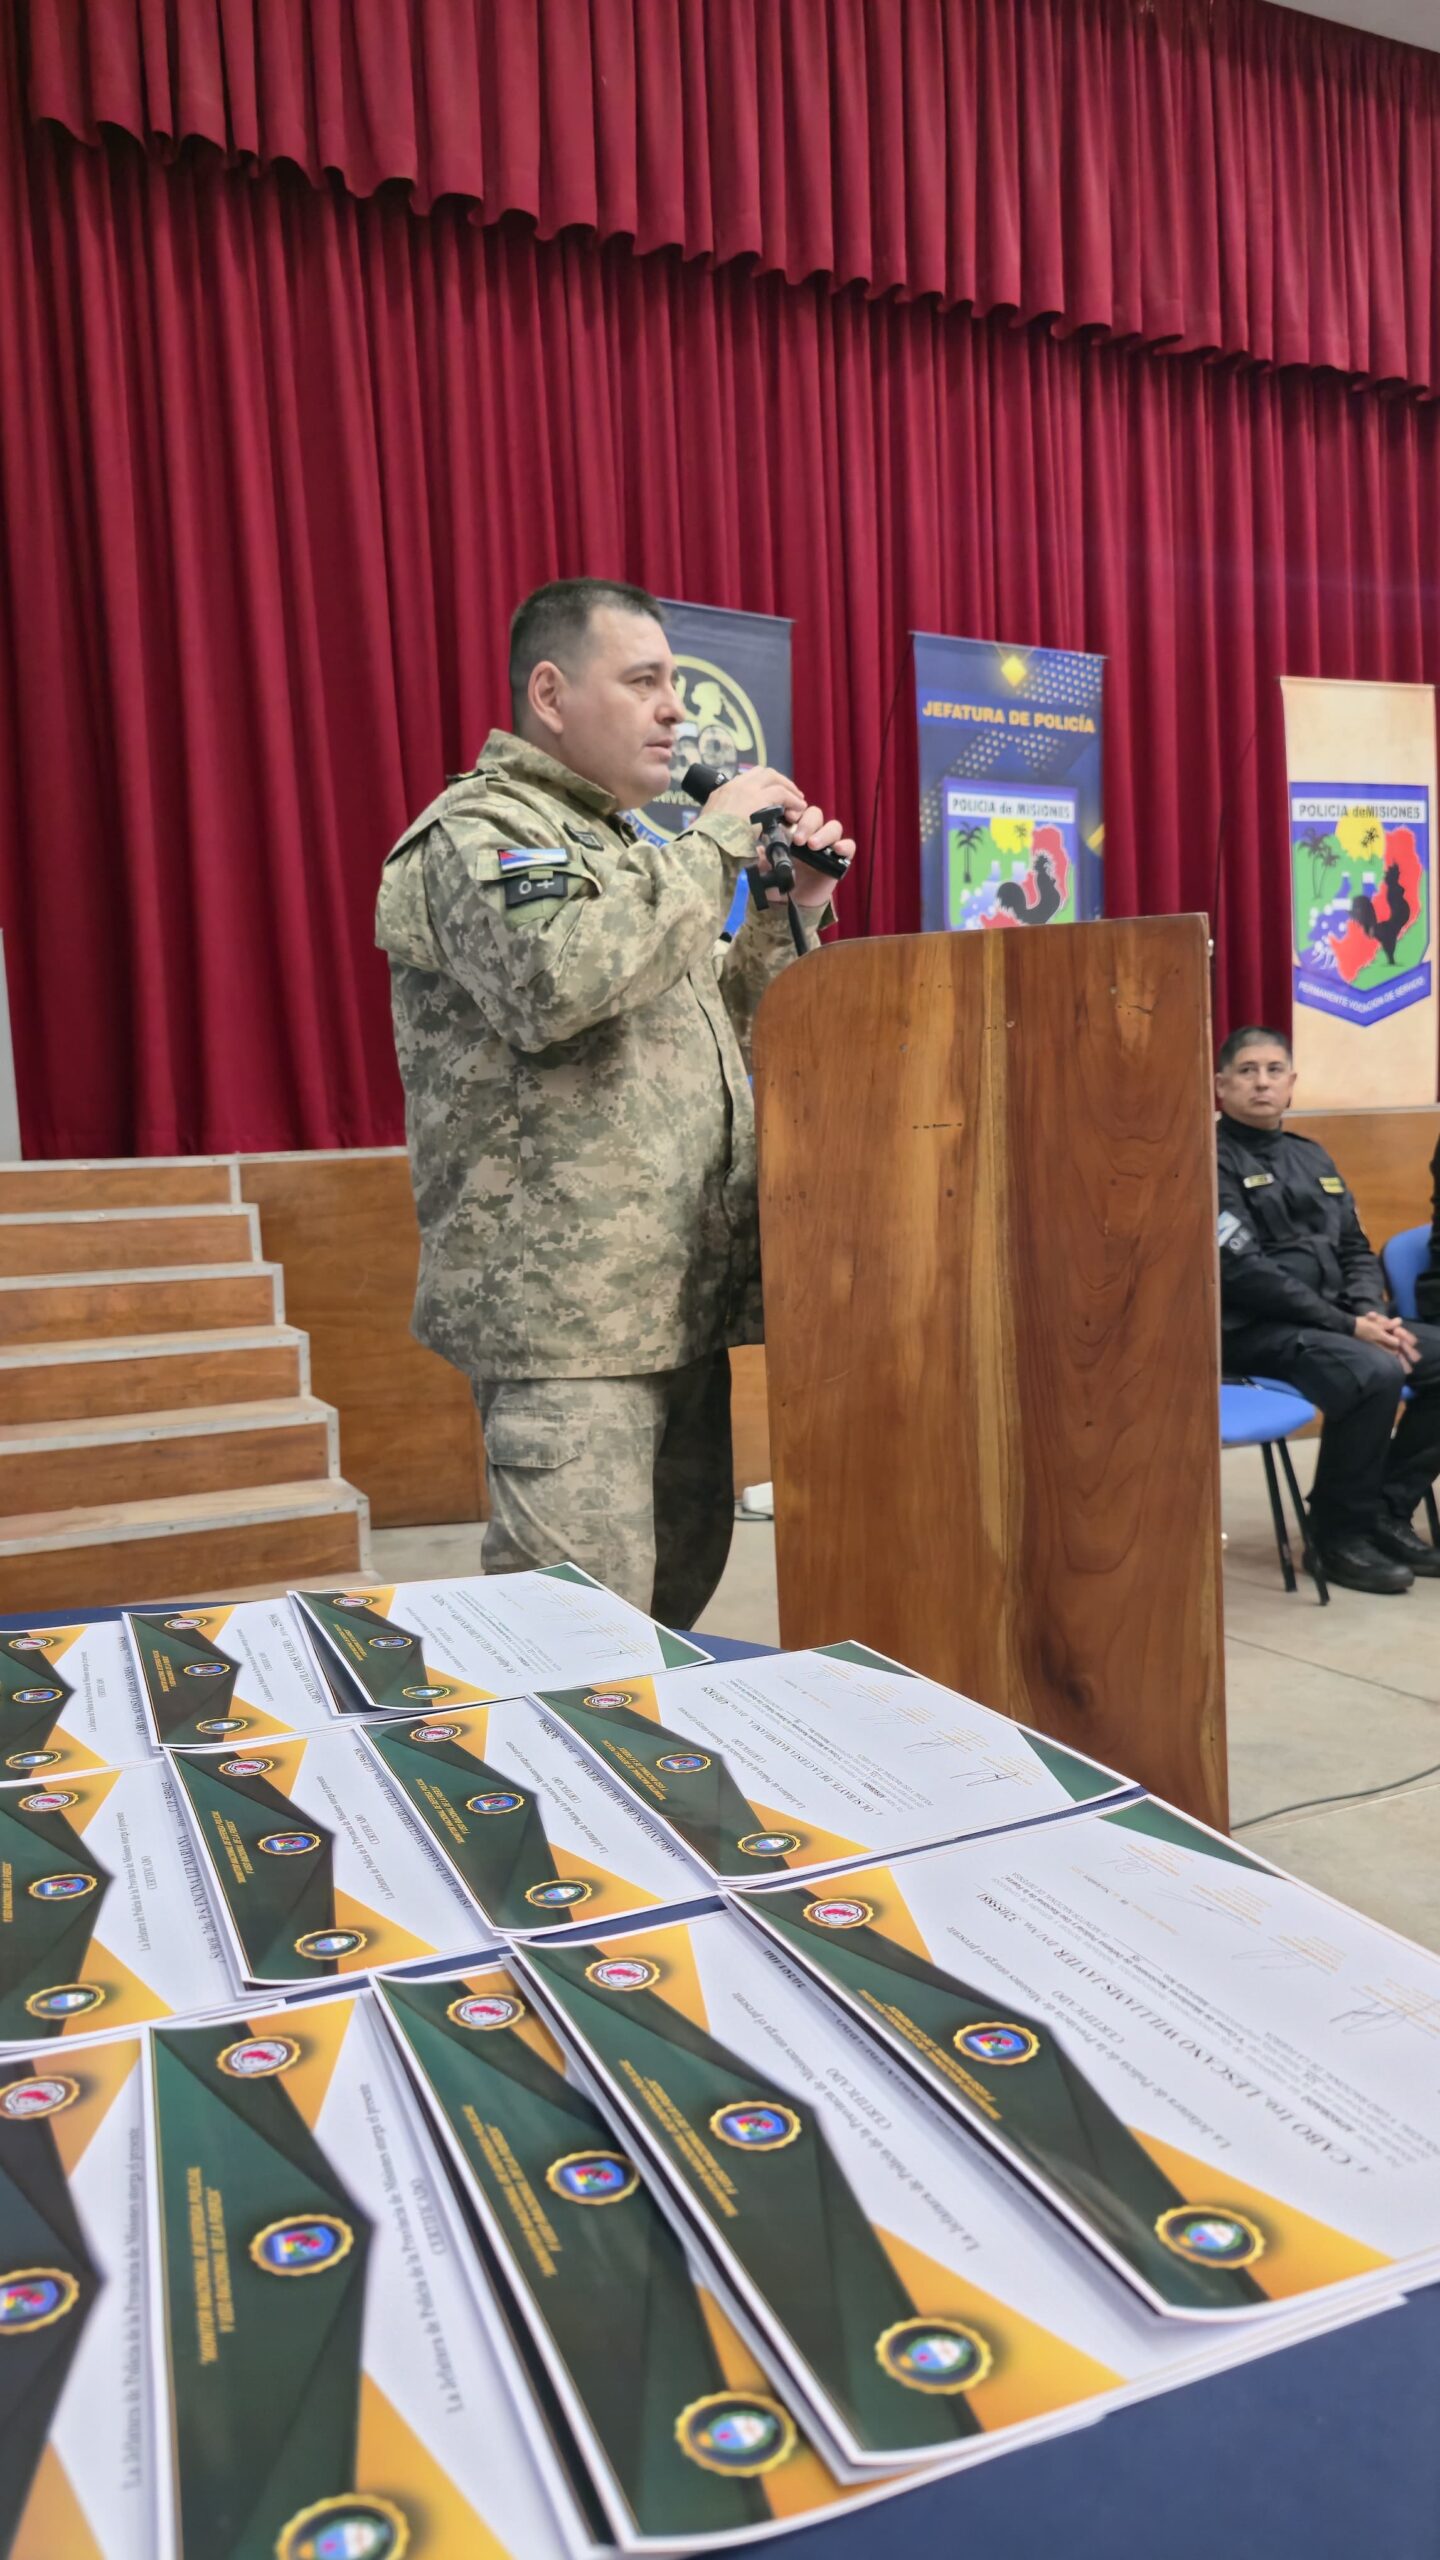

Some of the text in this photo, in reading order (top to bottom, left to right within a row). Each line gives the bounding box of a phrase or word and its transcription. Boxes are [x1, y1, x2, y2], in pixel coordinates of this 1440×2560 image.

[923, 701, 1096, 733] JEFATURA DE POLICÍA
[1016, 802, 1071, 818] MISIONES
[1299, 804, 1349, 818] POLICIA
[1048, 1947, 1110, 1984] JAVIER
[1047, 1989, 1127, 2044] CERTIFICADO
[1095, 1982, 1186, 2040] WILLIAMS
[1172, 2038, 1265, 2098] LESCANO
[823, 2066, 895, 2130] CERTIFICADO
[1285, 2121, 1356, 2166] CABO
